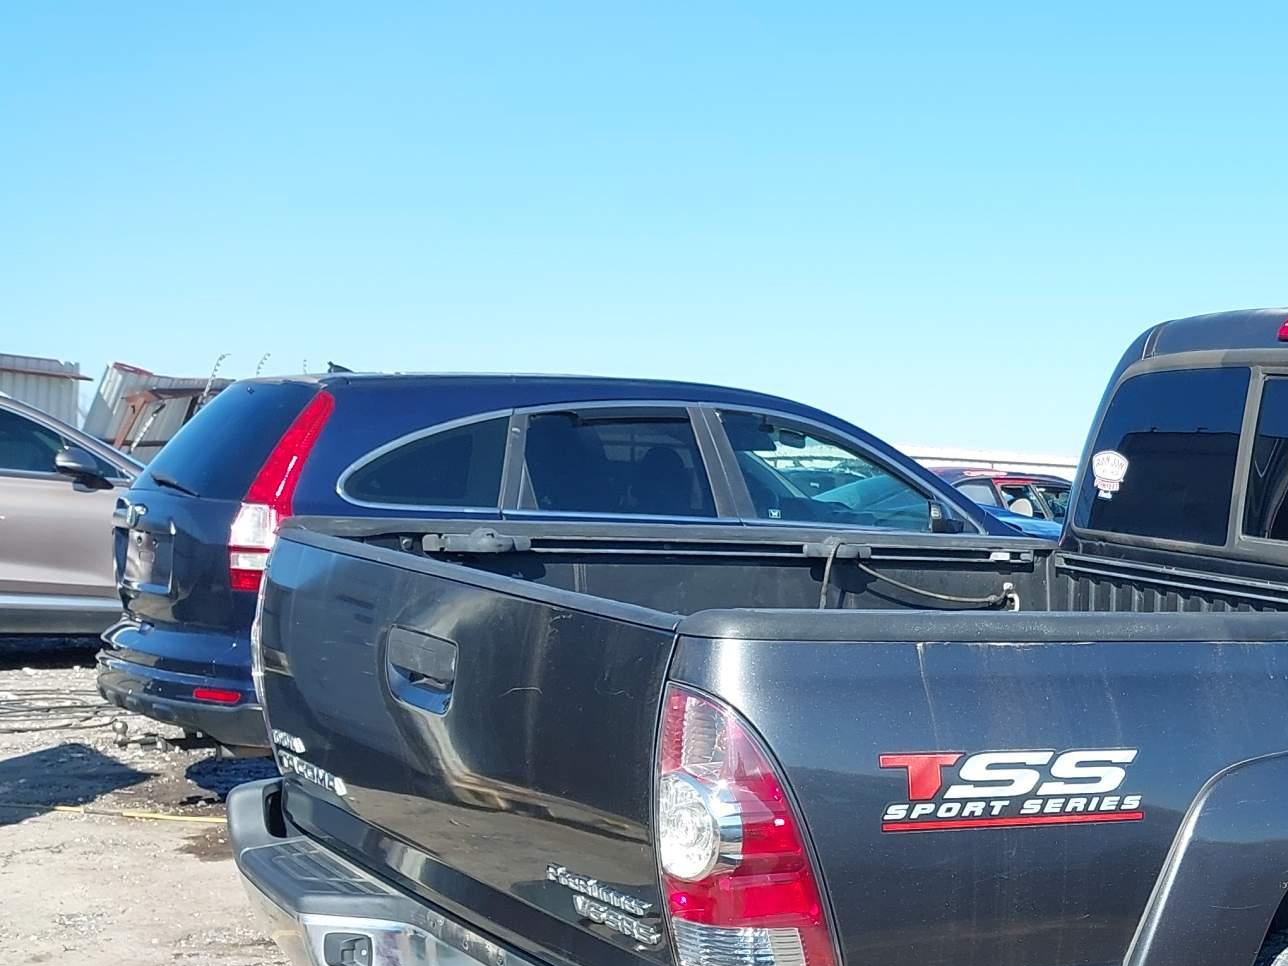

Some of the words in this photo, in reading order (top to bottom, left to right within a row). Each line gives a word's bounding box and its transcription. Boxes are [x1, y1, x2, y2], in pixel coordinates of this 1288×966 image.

[879, 749, 1139, 800] TSS
[883, 800, 1010, 820] SPORT
[1020, 795, 1142, 814] SERIES
